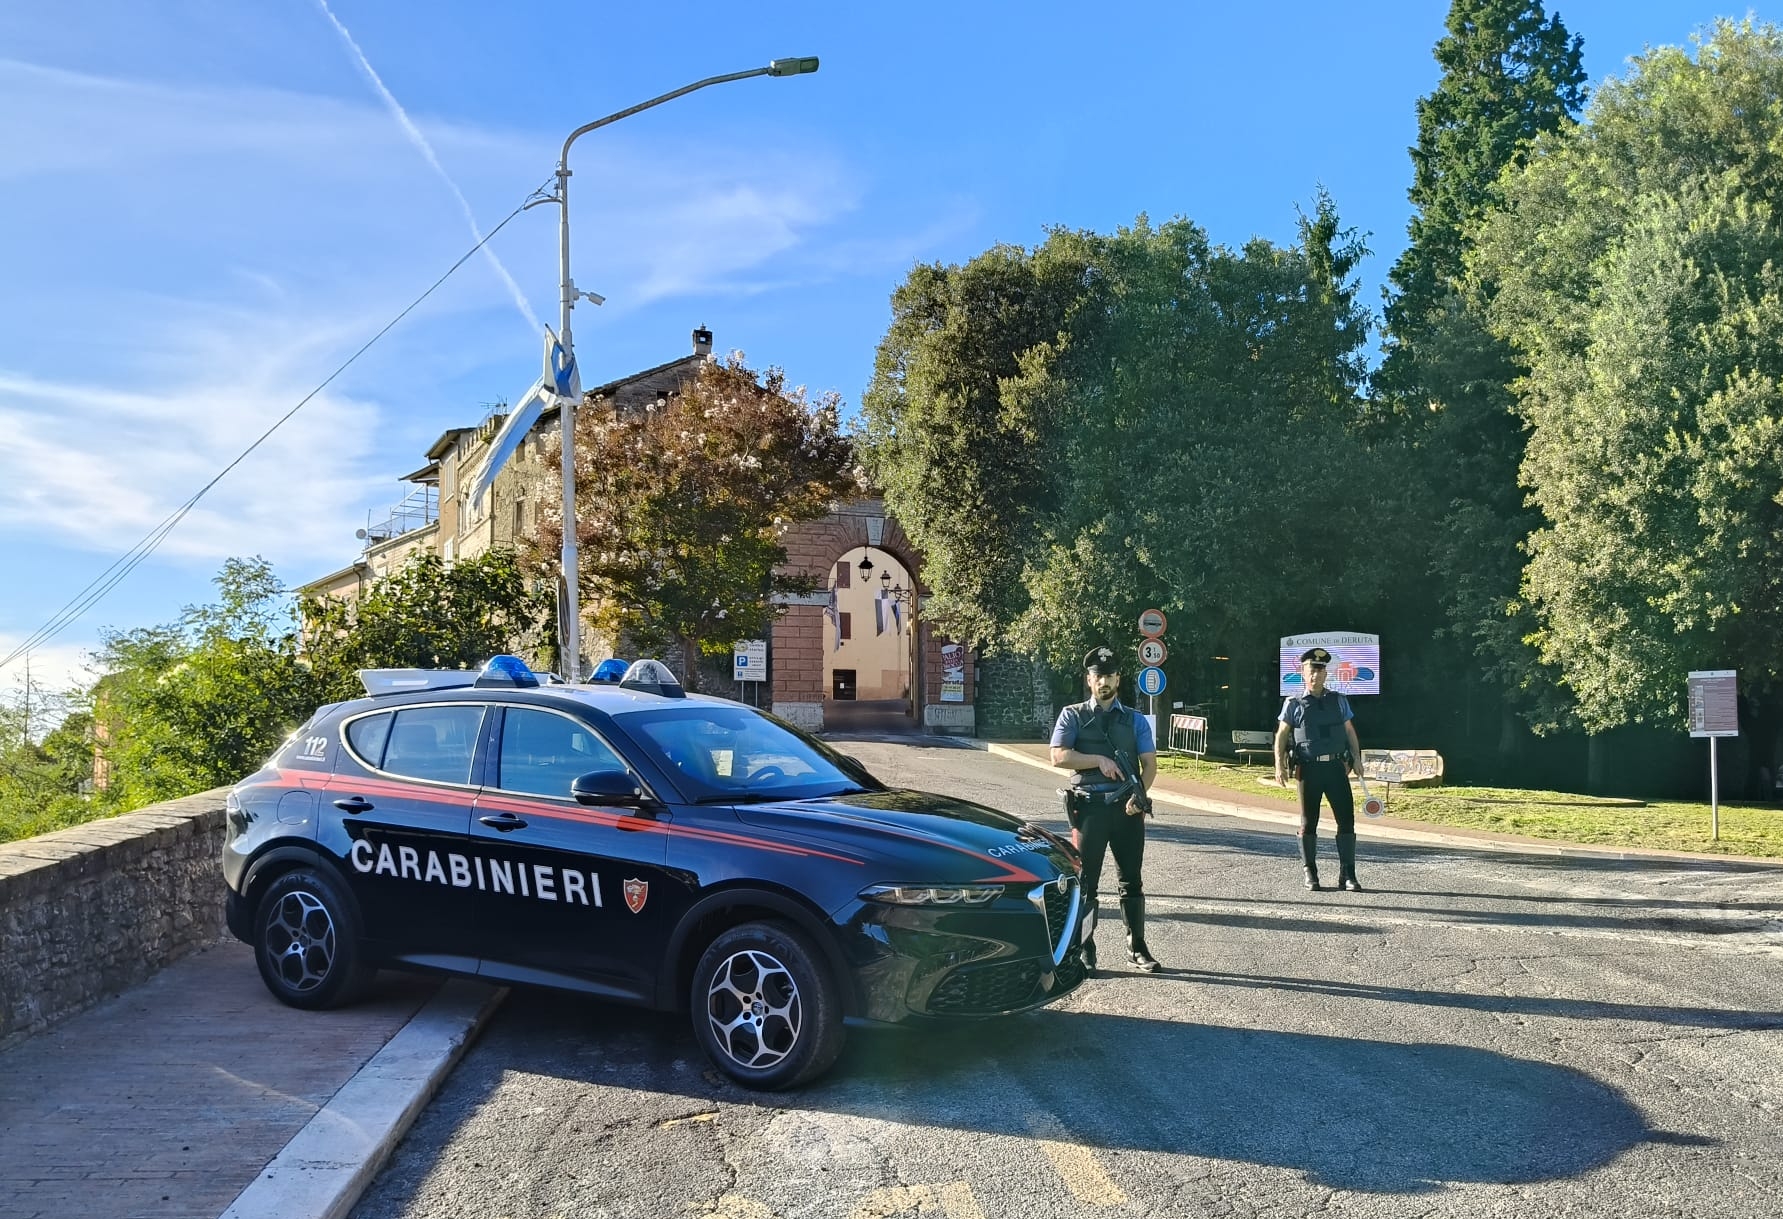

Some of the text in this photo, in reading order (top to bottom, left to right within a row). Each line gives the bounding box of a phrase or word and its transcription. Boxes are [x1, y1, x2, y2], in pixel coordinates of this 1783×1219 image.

[1297, 637, 1331, 645] COMUNE
[1341, 636, 1373, 644] DERUTA
[1146, 647, 1152, 658] 3
[304, 736, 327, 757] 112
[351, 838, 603, 908] CARABINIERI
